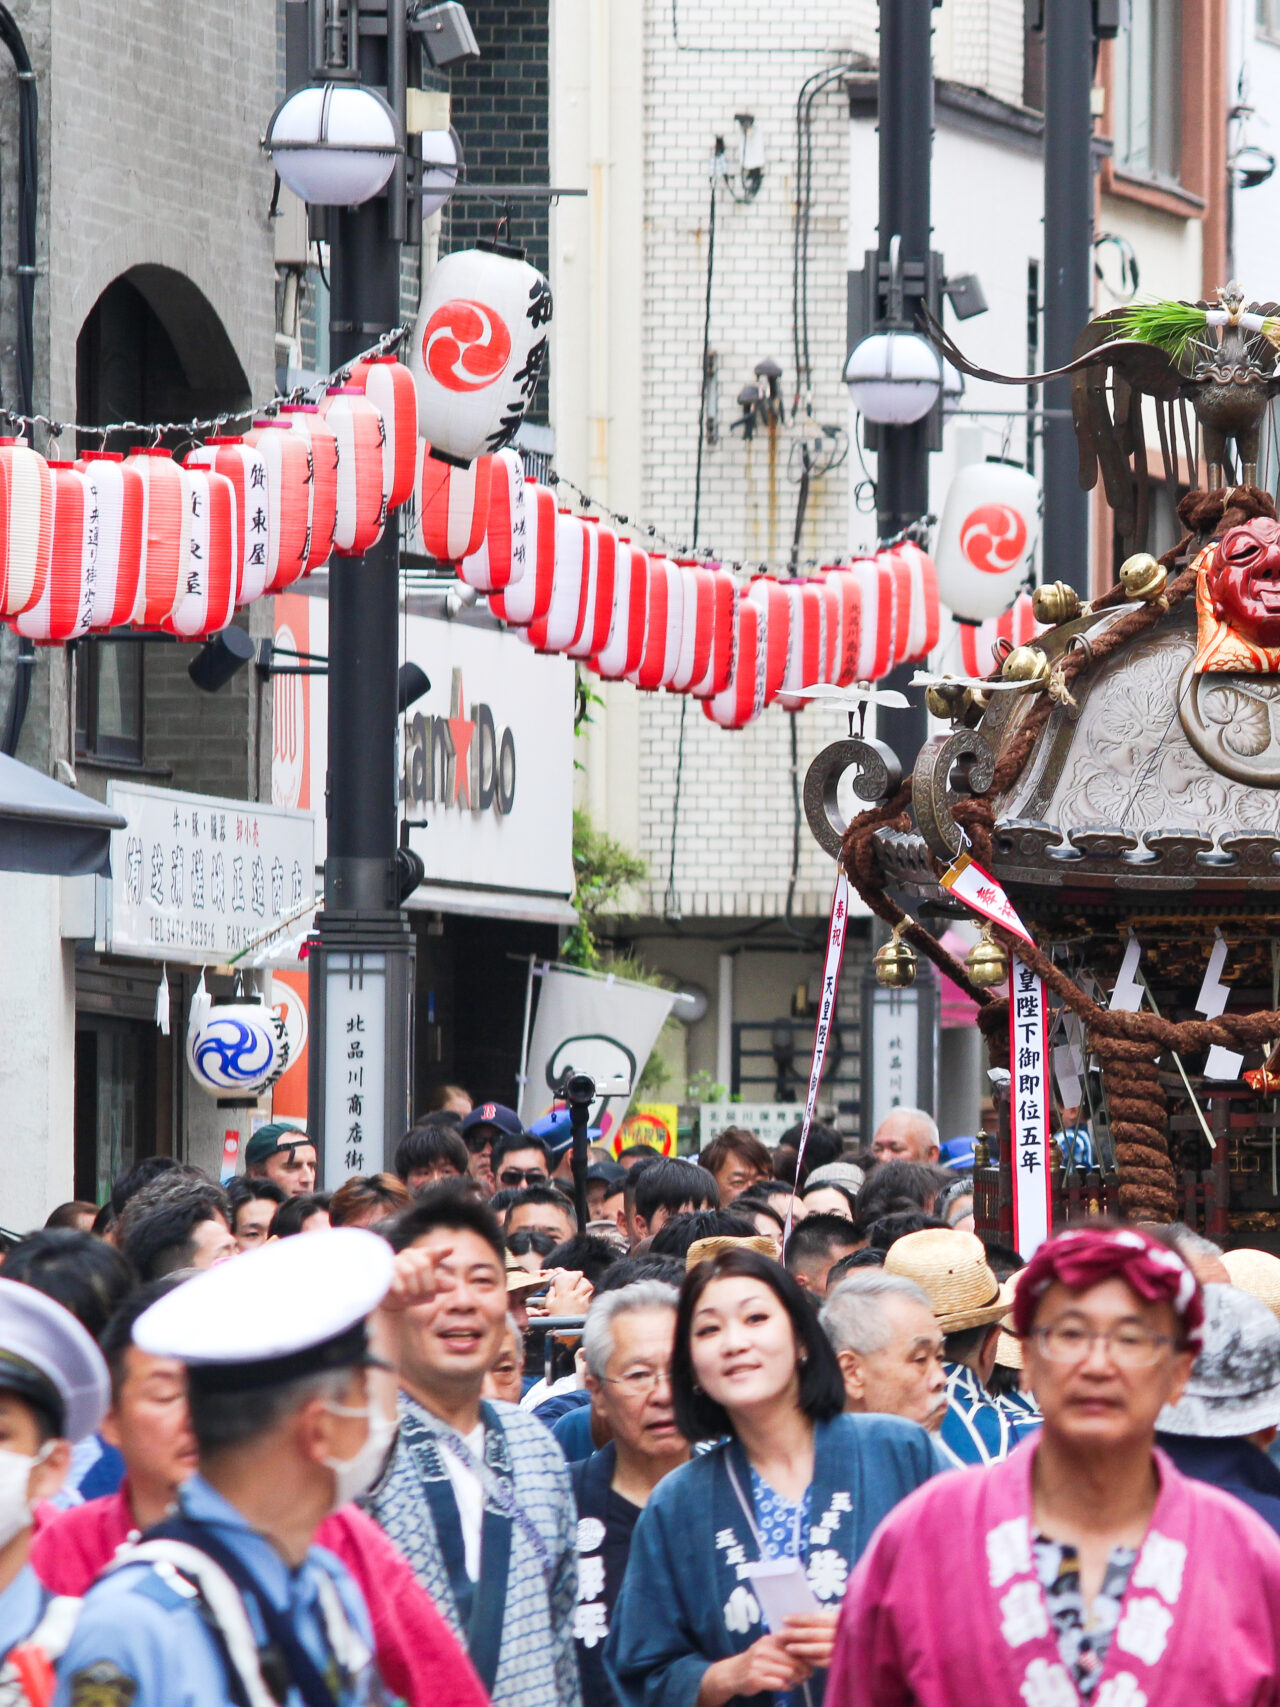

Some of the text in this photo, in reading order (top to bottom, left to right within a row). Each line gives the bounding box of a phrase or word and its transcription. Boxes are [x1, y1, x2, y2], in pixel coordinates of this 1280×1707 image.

[344, 1014, 366, 1171] 北品川商店街
[1017, 955, 1042, 1174] 皇陛下御即位五年
